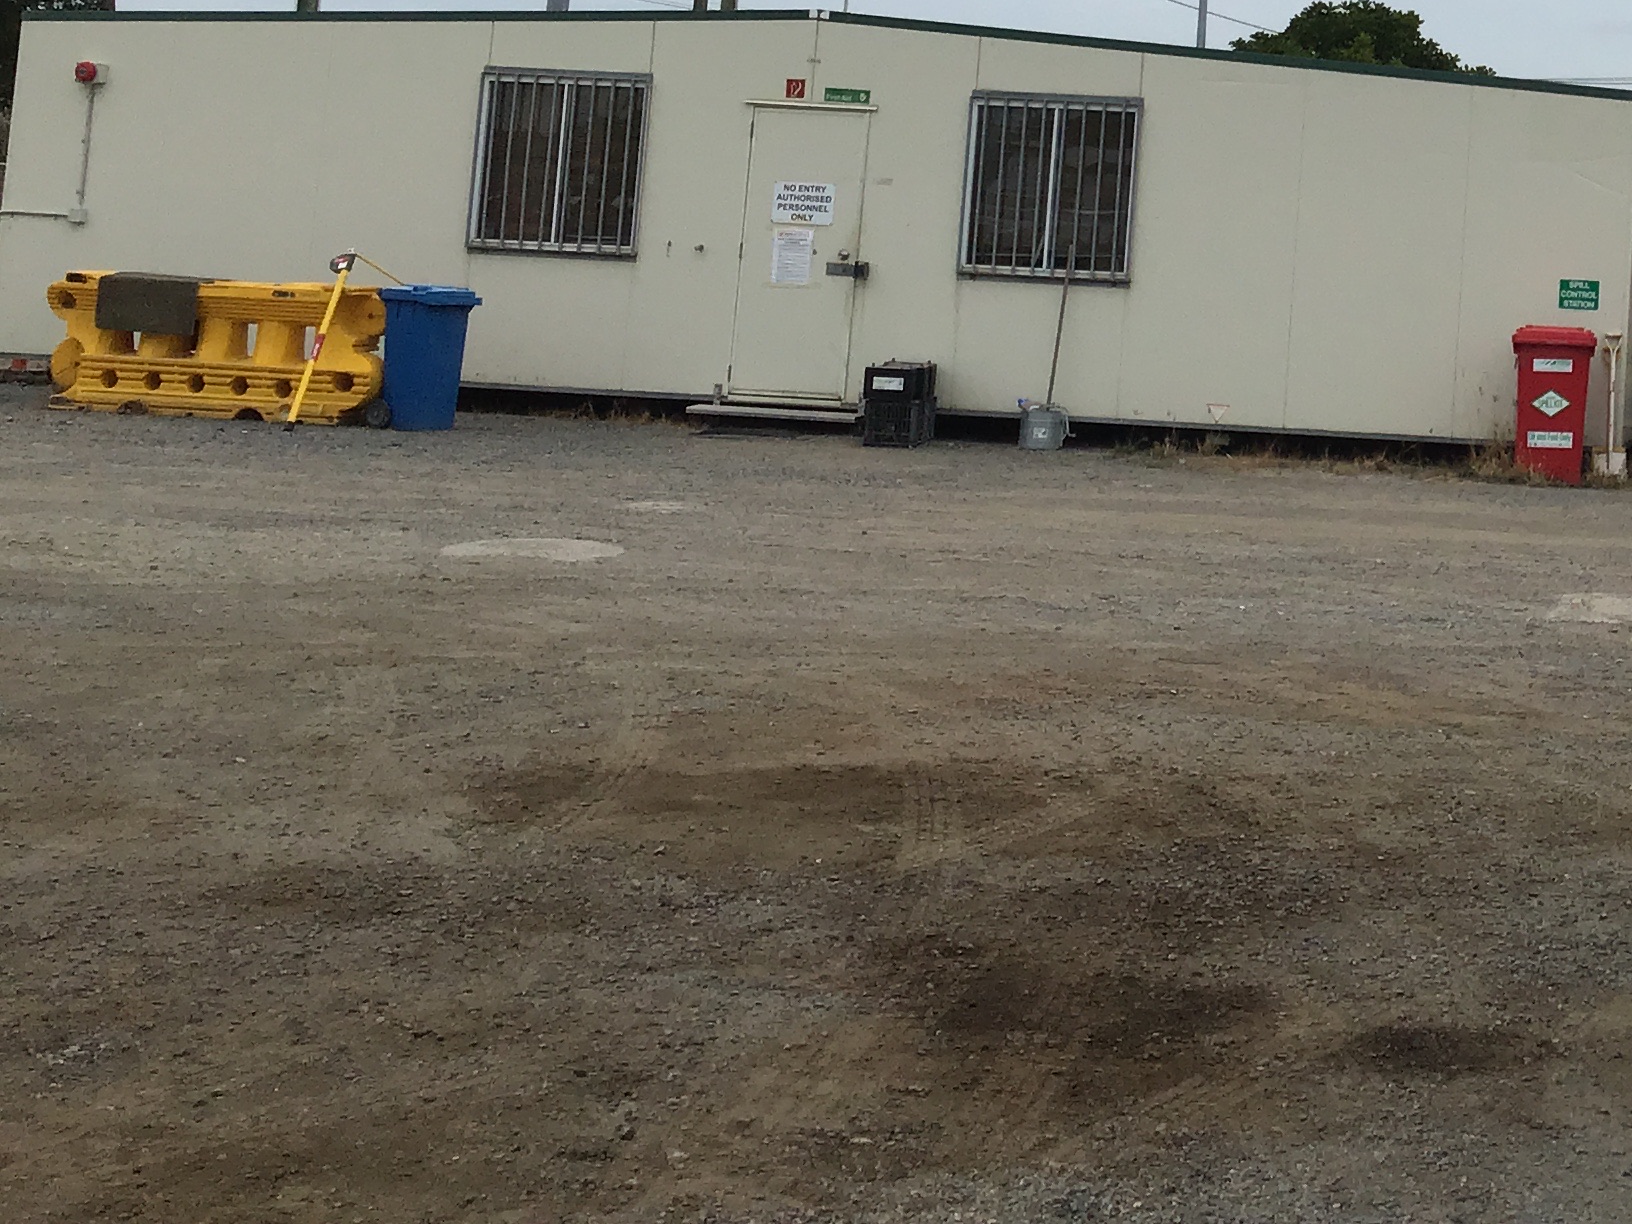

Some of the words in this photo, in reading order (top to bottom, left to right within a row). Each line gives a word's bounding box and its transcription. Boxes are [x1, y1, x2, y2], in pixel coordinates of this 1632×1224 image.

[783, 184, 797, 192] NO
[798, 184, 827, 194] ENTRY
[776, 194, 832, 204] AUTHORISED
[777, 203, 829, 213] PERSONNEL
[790, 213, 814, 222] ONLY
[1569, 281, 1590, 289] SPILL
[1561, 290, 1598, 299] CONTROL
[1563, 299, 1595, 308] STATION
